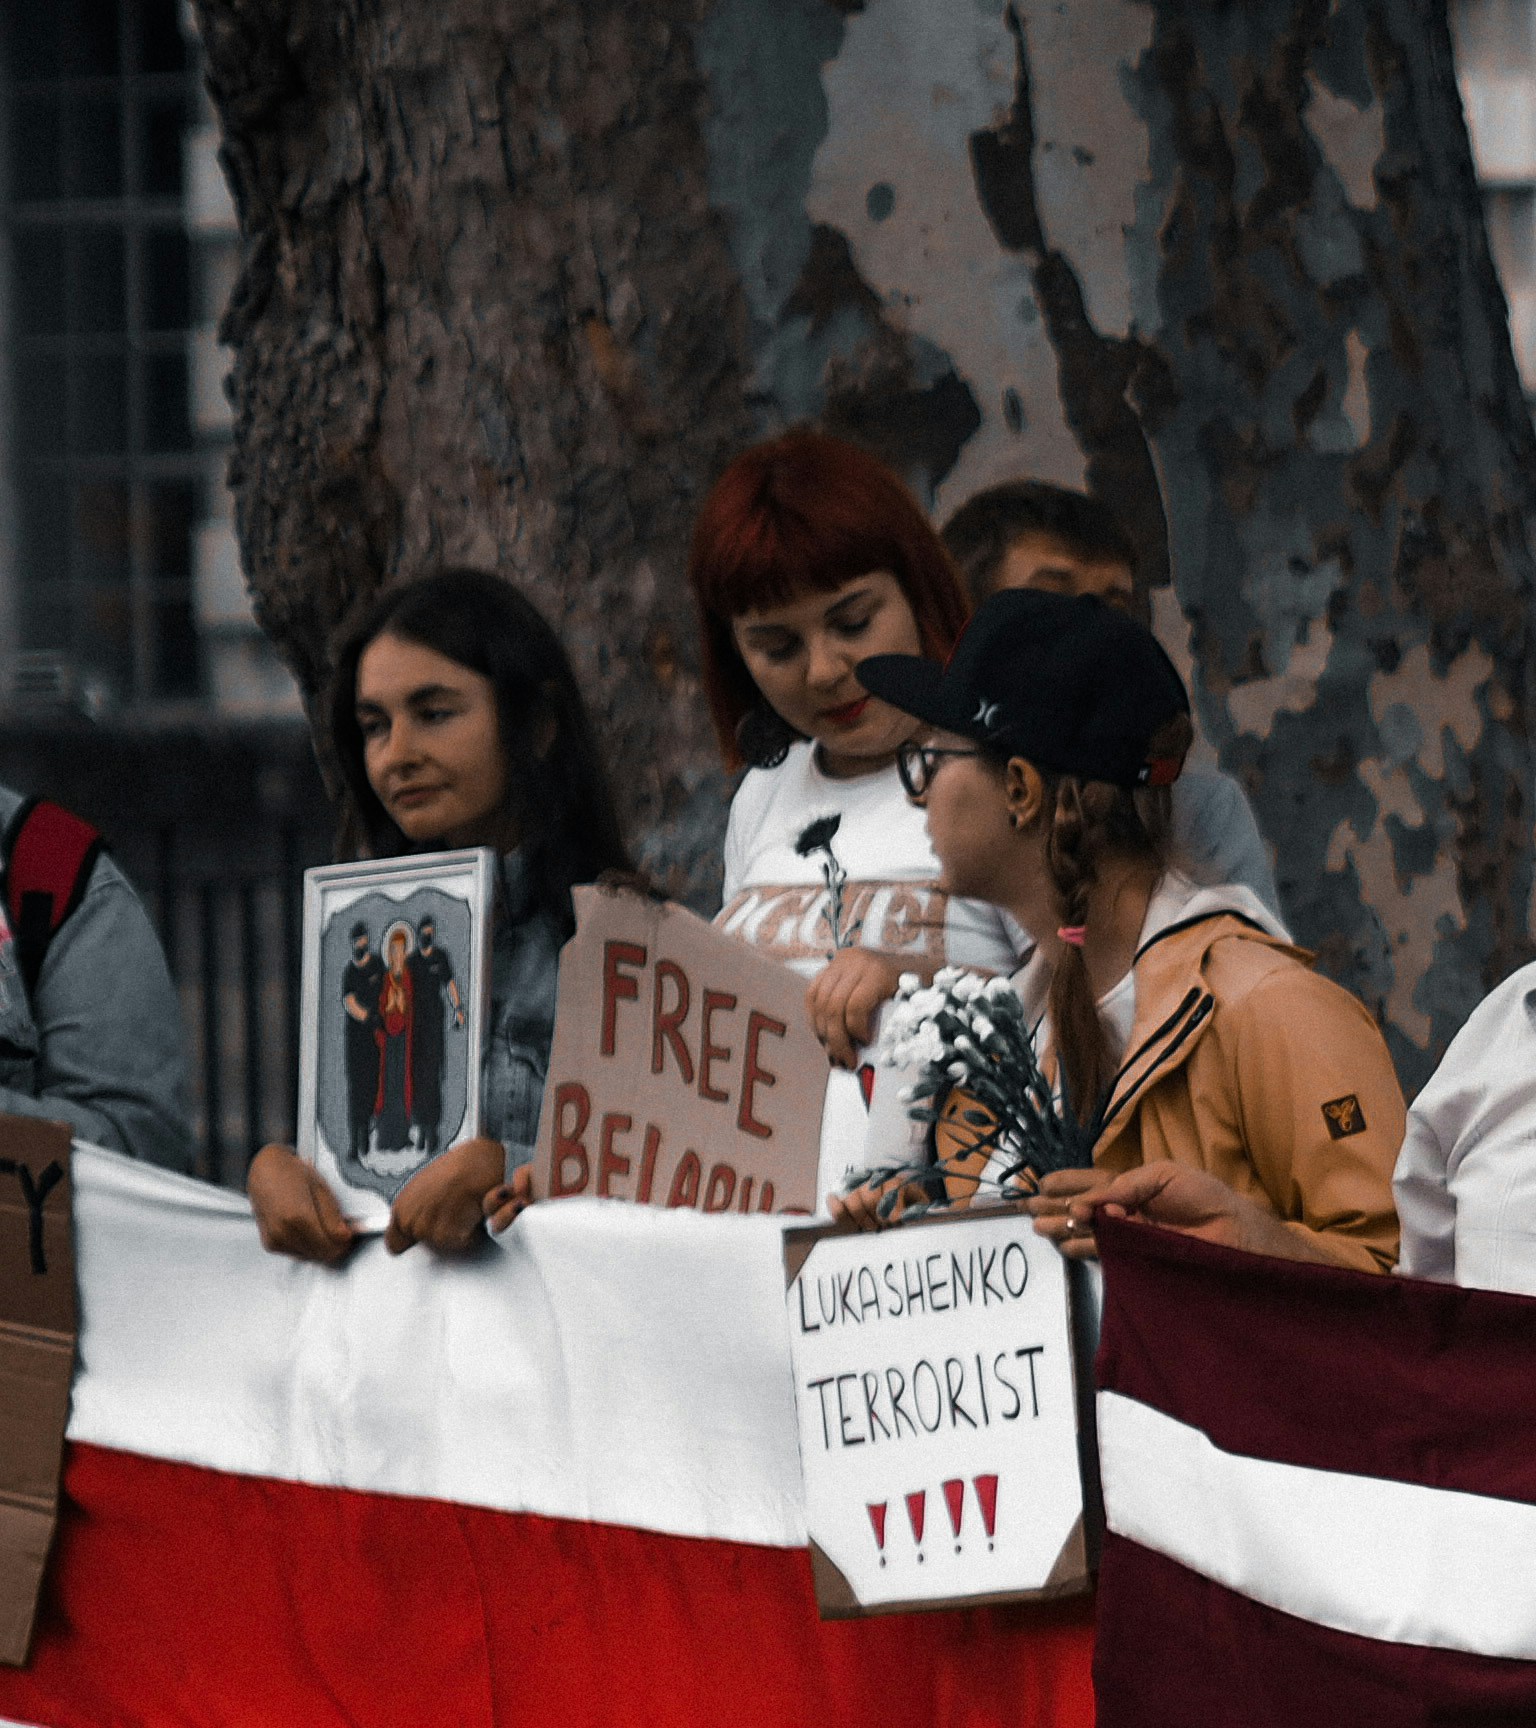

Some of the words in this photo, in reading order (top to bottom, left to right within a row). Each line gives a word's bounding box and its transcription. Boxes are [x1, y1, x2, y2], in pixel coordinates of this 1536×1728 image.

[600, 939, 787, 1139] FREE
[548, 1080, 814, 1217] BELAR
[797, 1241, 1030, 1334] LUKASHENKO
[807, 1346, 1045, 1451] TERRORIST
